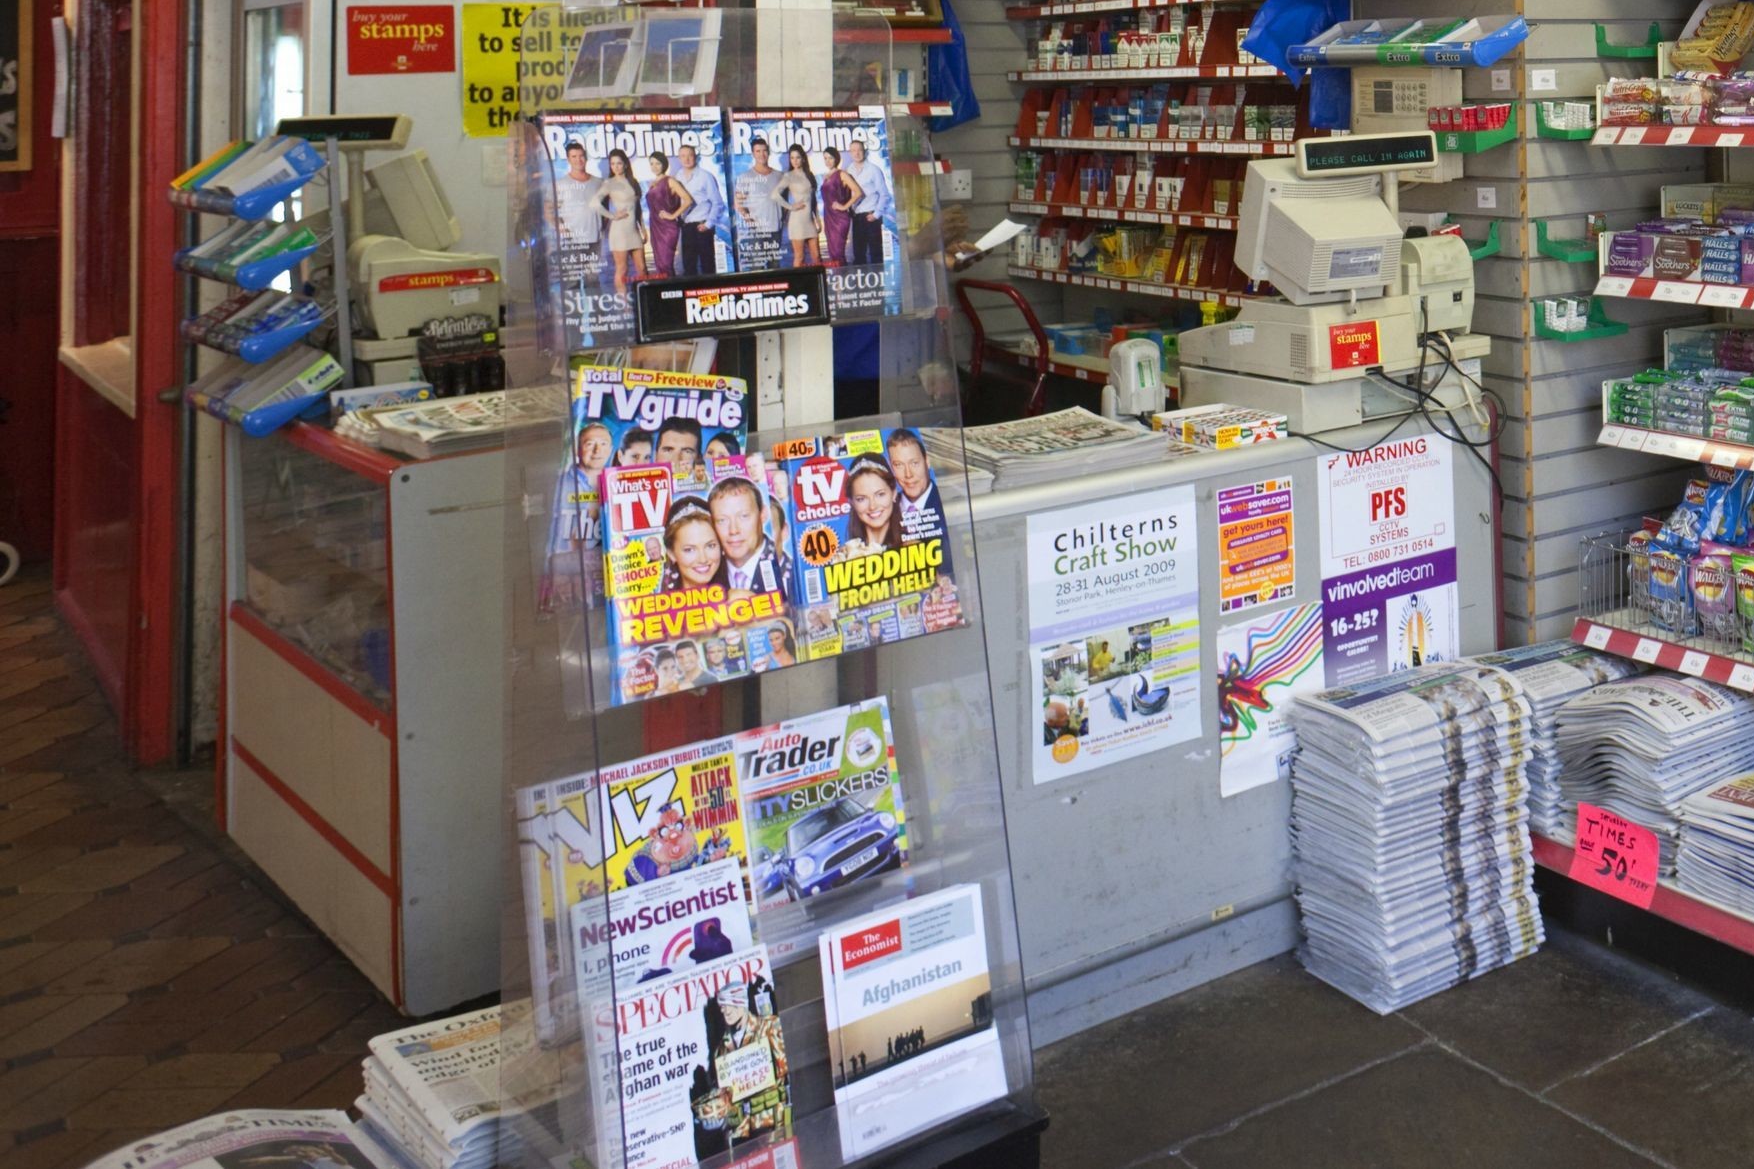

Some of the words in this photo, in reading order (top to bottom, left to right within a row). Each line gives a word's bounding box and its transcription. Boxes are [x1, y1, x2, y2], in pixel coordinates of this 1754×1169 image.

[352, 9, 376, 24] buy
[380, 12, 407, 23] your
[502, 7, 522, 27] It
[361, 20, 443, 43] stamps
[479, 33, 503, 53] to
[512, 32, 552, 52] sell
[413, 40, 438, 53] here
[1386, 51, 1410, 63] Extra
[469, 83, 493, 103] to
[1310, 156, 1345, 165] PLEASE
[1352, 155, 1374, 163] CALL
[1398, 150, 1426, 159] AGAIN
[562, 287, 634, 314] Stress
[686, 291, 809, 325] RadioTimes
[1336, 331, 1372, 346] stamps
[582, 368, 623, 384] Total
[655, 372, 717, 388] Freeview
[1346, 438, 1427, 469] WARNING
[1333, 474, 1366, 487] SECURITY
[1367, 469, 1394, 481] SYSTEM
[1403, 459, 1440, 474] OPERATION
[1354, 465, 1372, 475] HOUR
[1374, 458, 1410, 472] RECORDED
[610, 479, 651, 493] What's
[653, 477, 669, 490] on
[1365, 476, 1396, 490] INSTALLED
[612, 488, 670, 531] TV
[797, 501, 851, 522] choice
[1221, 494, 1289, 515] ukwebsaver.com
[1370, 486, 1407, 521] PFS
[1055, 514, 1177, 552] Chilterns
[1223, 525, 1238, 538] get
[1240, 521, 1264, 534] yours
[1267, 515, 1288, 529] here!
[1370, 527, 1409, 545] SYSTEMS
[1379, 522, 1399, 532] CCTV
[610, 549, 645, 564] Dawn's
[1055, 544, 1107, 575] Craft
[1115, 536, 1177, 563] Show
[1343, 556, 1366, 569] TEL:
[1368, 549, 1391, 563] 0800
[1394, 544, 1410, 556] 731
[1412, 538, 1434, 552] 0514
[614, 566, 658, 583] SHOCKS
[825, 540, 943, 594] WEDDING
[1055, 578, 1089, 596] 28-31
[1093, 568, 1140, 589] August
[1144, 559, 1176, 577] 2009
[839, 580, 893, 611] FROM
[891, 569, 936, 599] HELL!
[1055, 592, 1082, 607] Stonor
[1105, 573, 1176, 596] Henley-on-Thames
[1328, 562, 1434, 602] vinvolvedteam
[620, 585, 724, 618] WEDDING
[622, 592, 785, 644] REVENGE!
[1331, 608, 1379, 637] 16-25?
[761, 732, 801, 752] Auto
[628, 760, 669, 777] JACKSON
[671, 749, 701, 767] TRIBUTE
[739, 734, 840, 781] Trader
[691, 771, 732, 799] ATTACK
[693, 806, 738, 831] WIMMIN
[1586, 818, 1636, 849] TIMES
[844, 934, 899, 961] Economist
[861, 957, 963, 1007] Afghanistan
[635, 1033, 666, 1057] true
[665, 1062, 690, 1081] war
